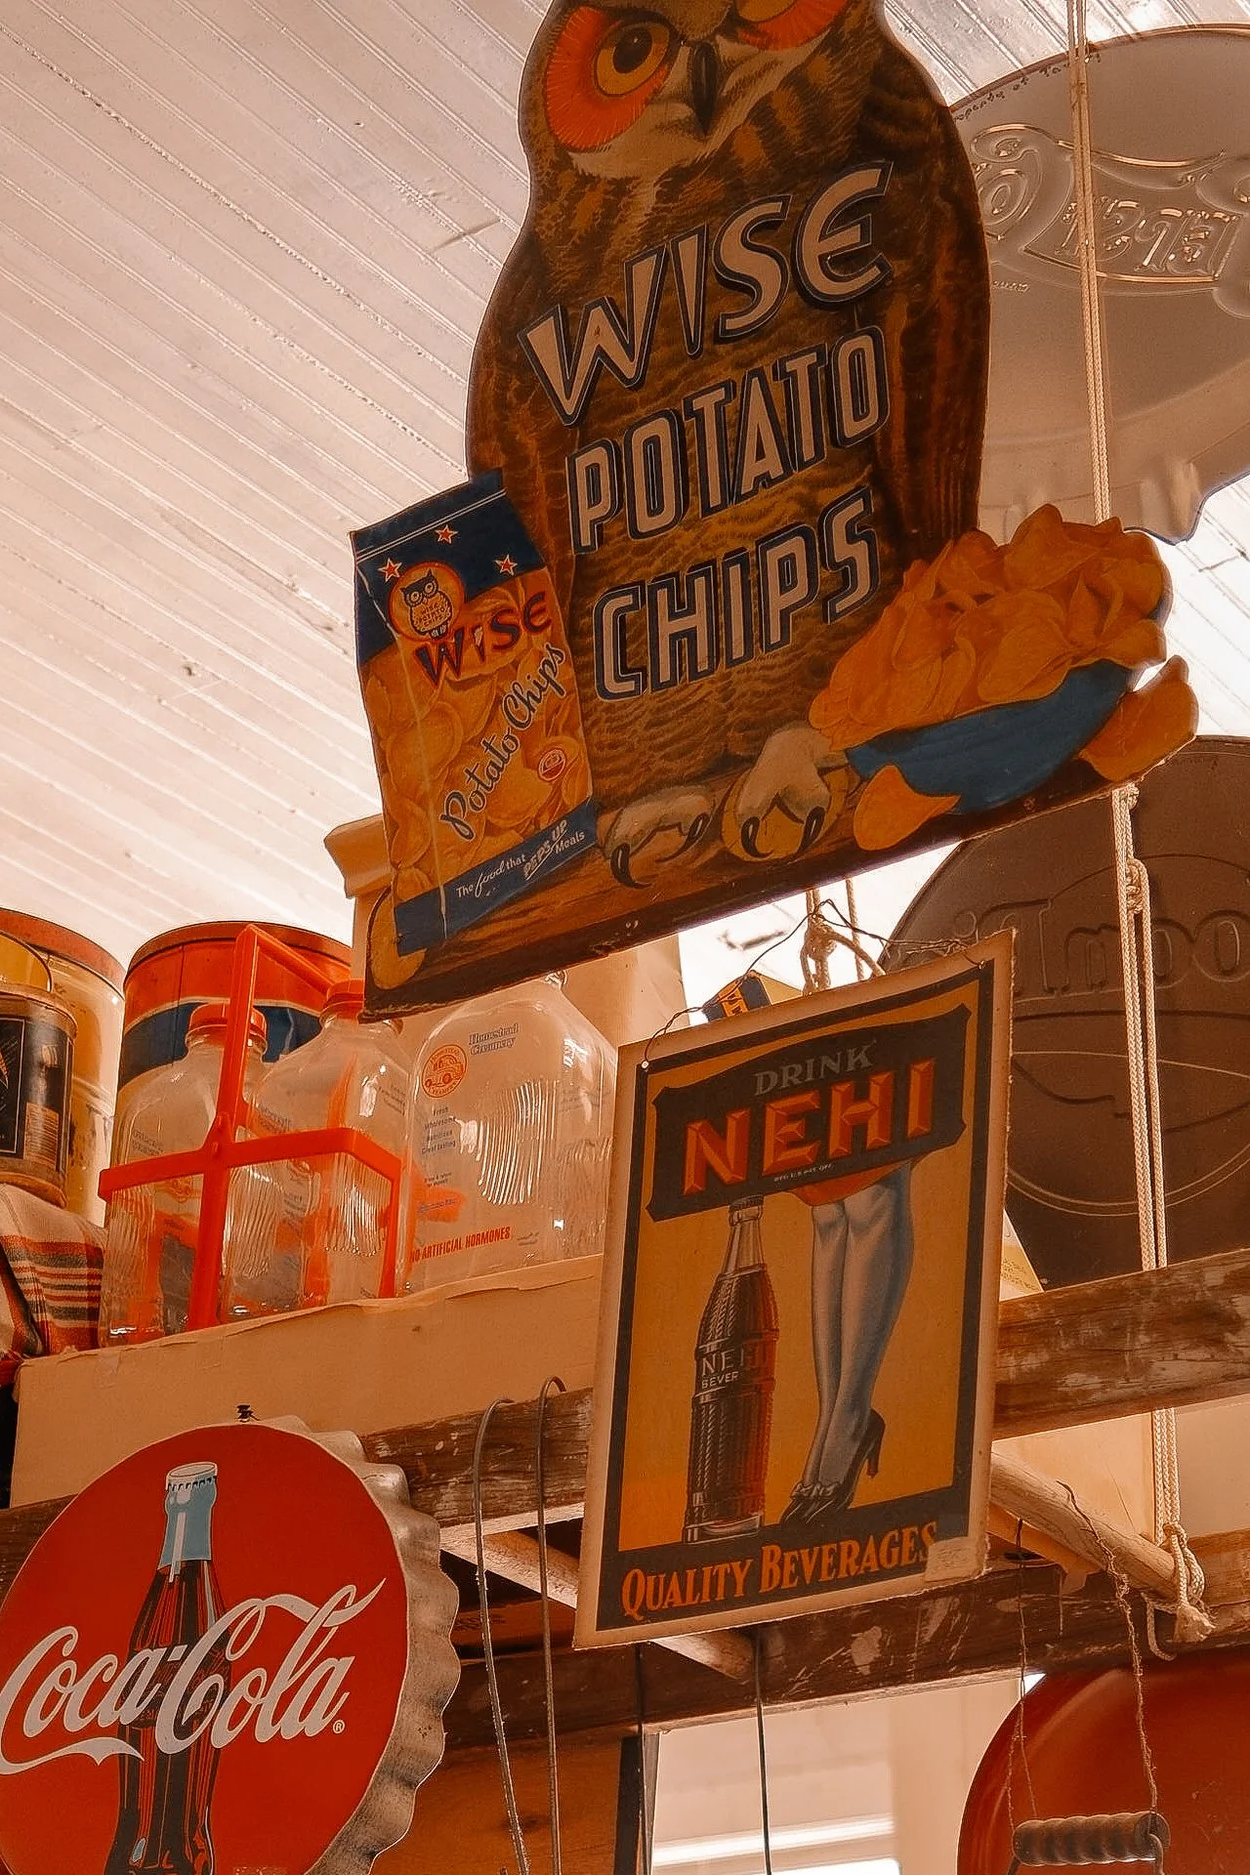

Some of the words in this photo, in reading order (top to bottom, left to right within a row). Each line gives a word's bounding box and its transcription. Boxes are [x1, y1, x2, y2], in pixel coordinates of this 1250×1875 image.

[518, 160, 895, 427] WISE
[565, 325, 891, 555] POTATO
[415, 591, 551, 688] WISE
[593, 483, 881, 700] CHIPS
[439, 728, 522, 841] Potato
[502, 641, 567, 732] Chips
[504, 853, 526, 872] that
[551, 819, 569, 842] UP
[554, 830, 586, 856] Meals
[456, 884, 474, 899] The
[753, 1044, 874, 1097] DRINK
[683, 1057, 937, 1196] NEHI
[422, 1237, 464, 1259] ARTIFICIAL
[465, 1226, 511, 1246] HORMONES
[621, 1559, 754, 1622] QUALITY
[759, 1521, 938, 1594] BEVERAGES
